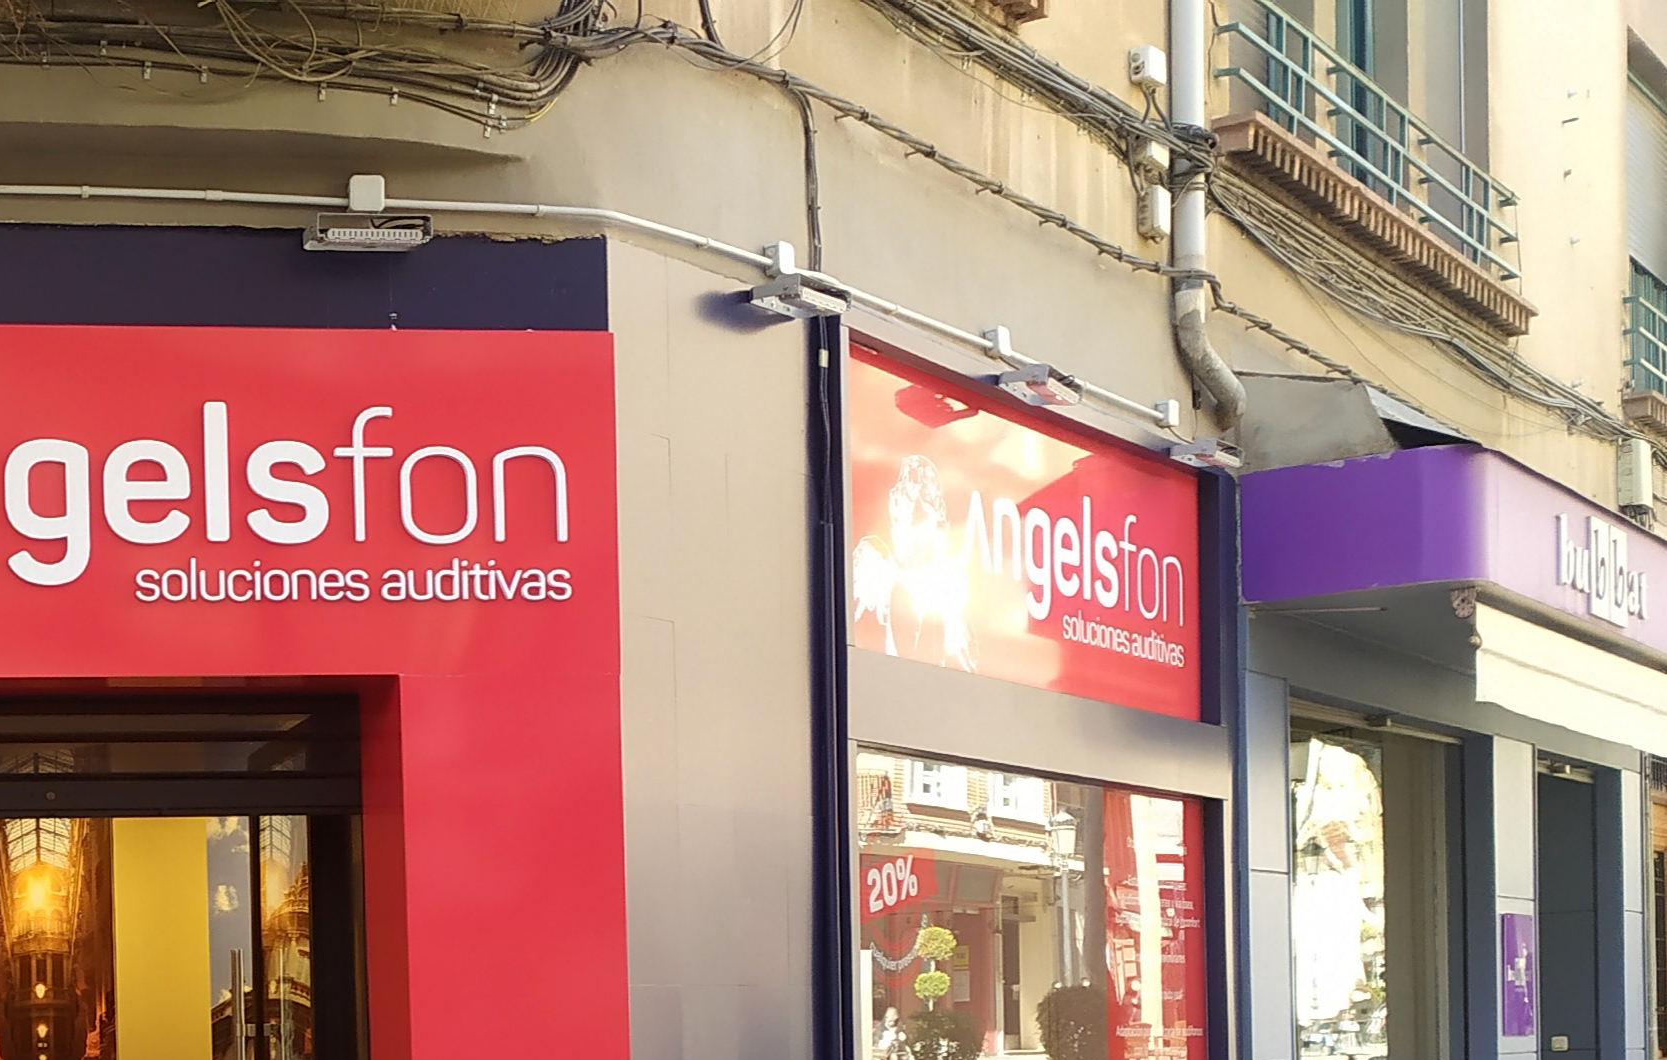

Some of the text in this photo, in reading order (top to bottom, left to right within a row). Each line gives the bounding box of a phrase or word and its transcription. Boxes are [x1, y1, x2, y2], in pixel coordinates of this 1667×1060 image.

[135, 556, 573, 603] soluciones auditivas
[963, 489, 1185, 627] Angelsfon
[1062, 609, 1185, 668] soluciones auditivas
[866, 854, 919, 913] 20%
